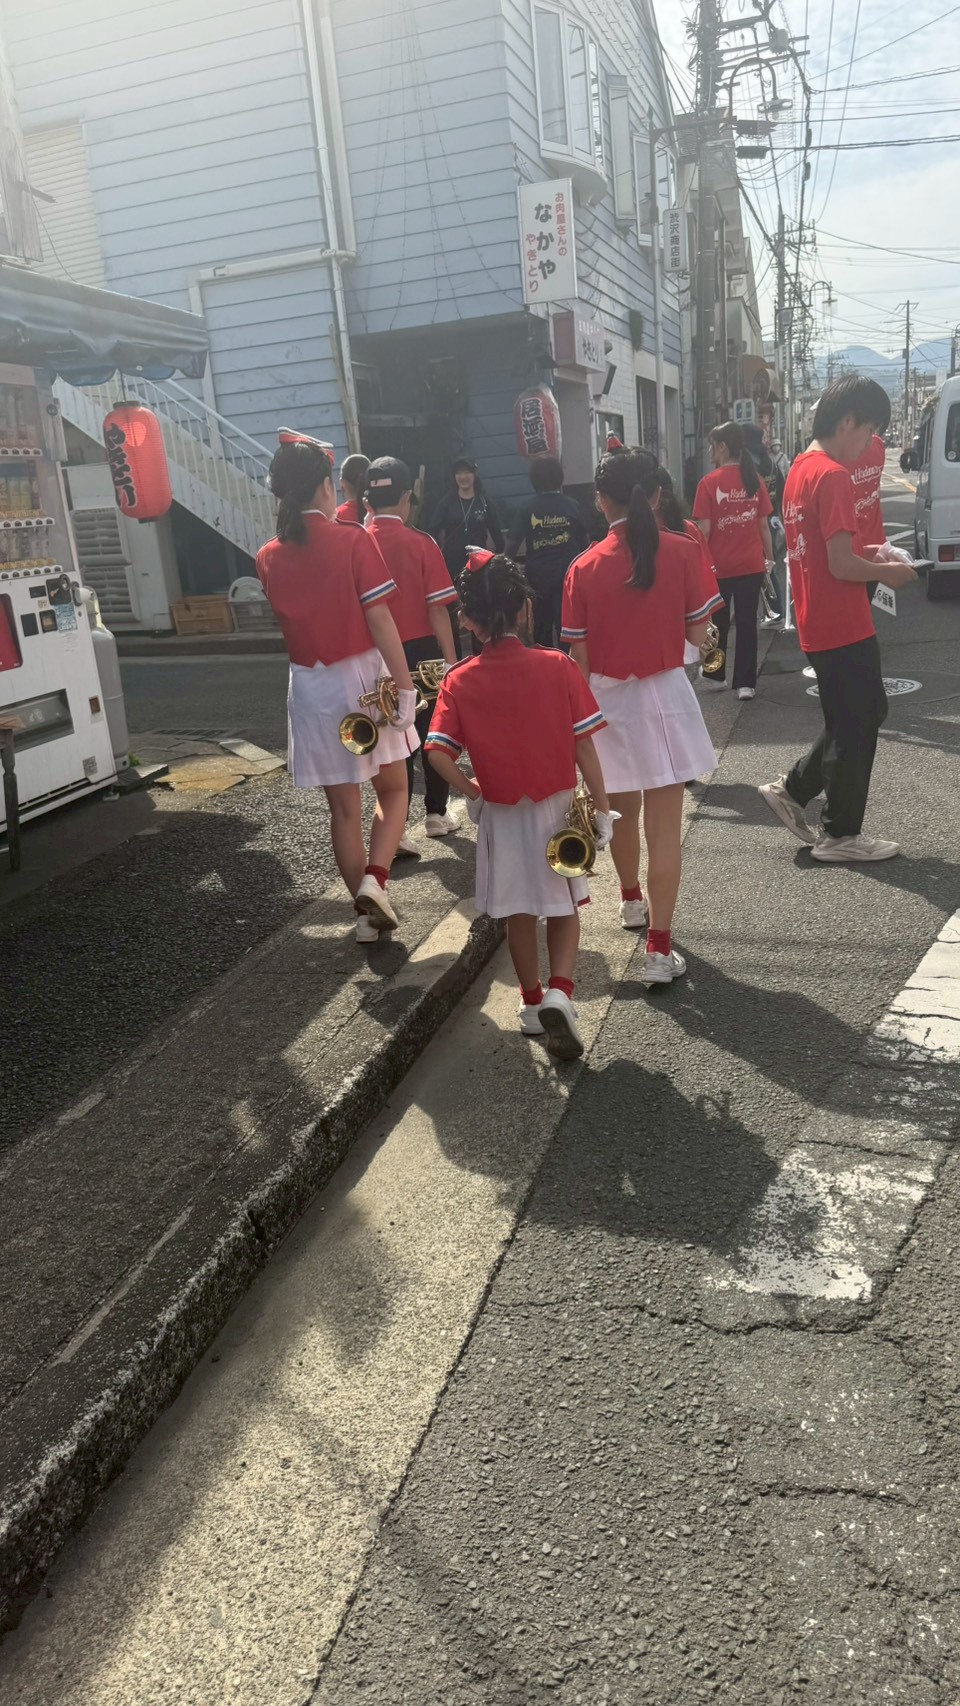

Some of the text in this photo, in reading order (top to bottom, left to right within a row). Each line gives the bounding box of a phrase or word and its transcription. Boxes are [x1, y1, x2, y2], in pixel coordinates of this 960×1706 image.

[534, 203, 556, 280] なかや
[555, 192, 567, 256] お肉屋さんの
[526, 233, 538, 293] やきとり
[521, 398, 549, 454] 居酒屋
